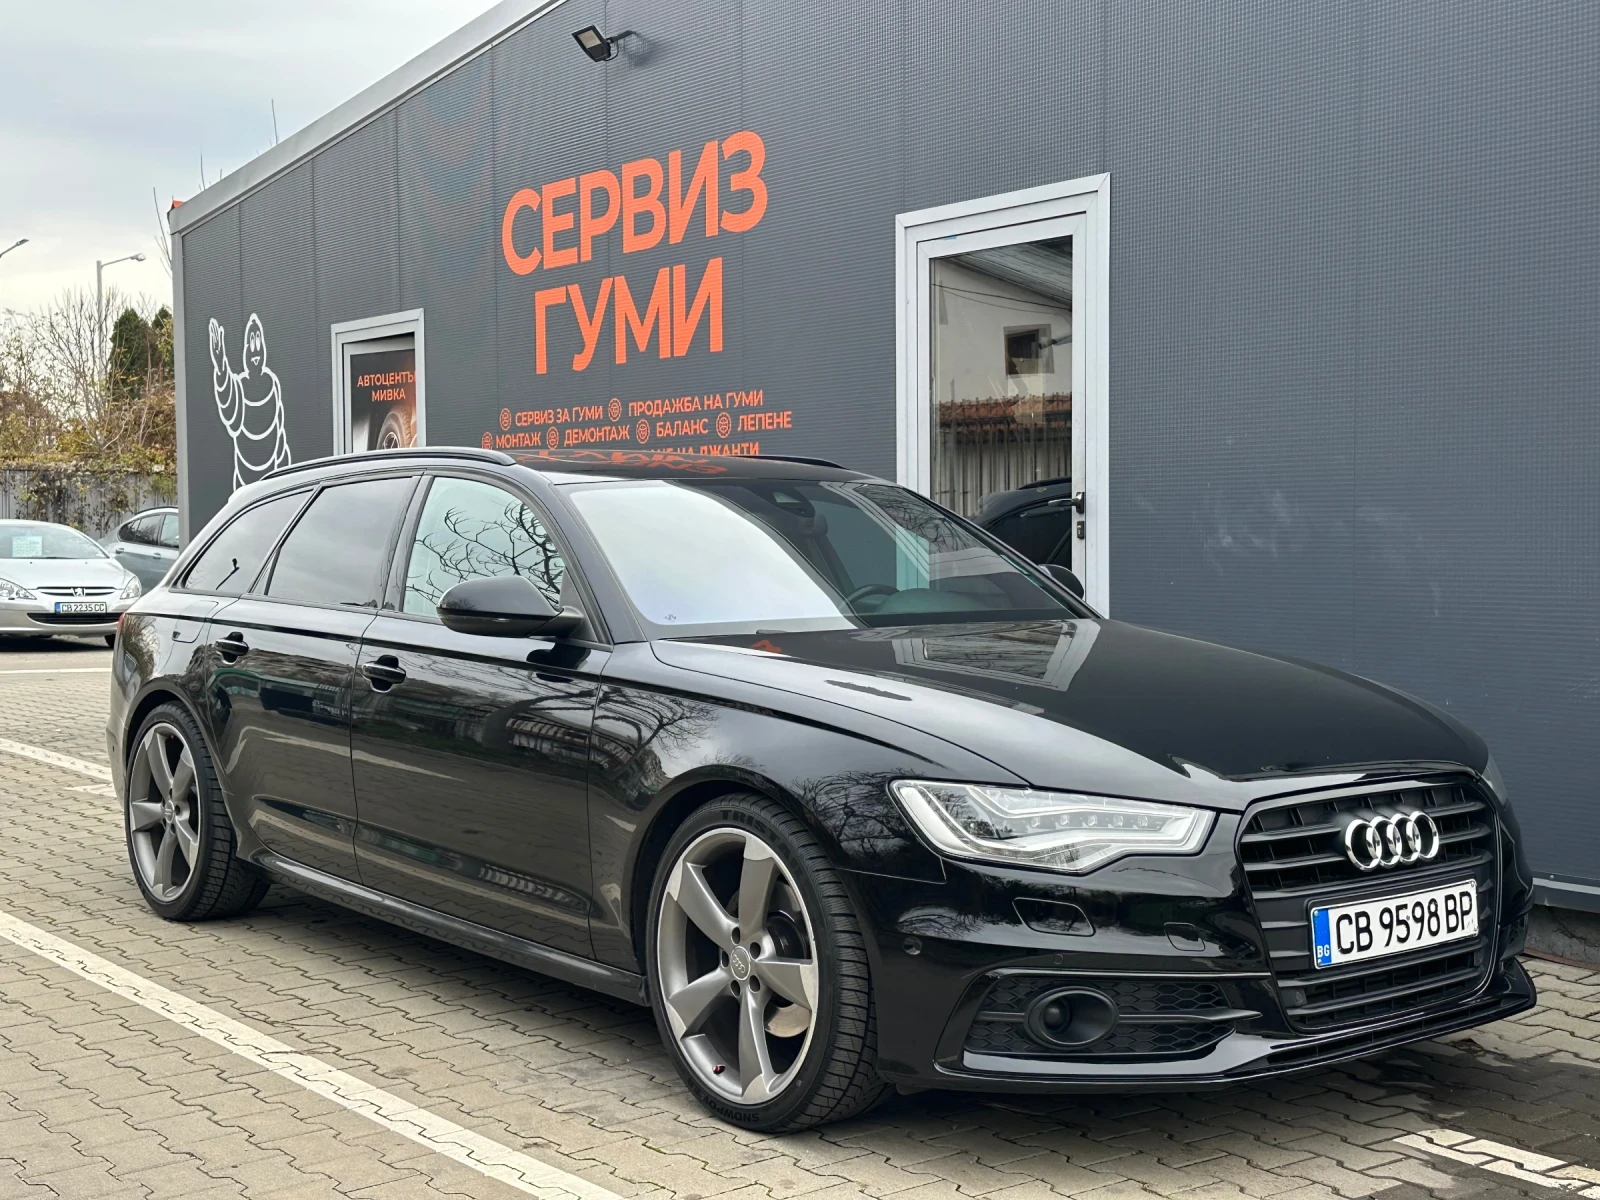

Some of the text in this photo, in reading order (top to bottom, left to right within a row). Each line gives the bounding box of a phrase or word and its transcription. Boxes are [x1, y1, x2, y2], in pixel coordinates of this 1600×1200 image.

[502, 130, 768, 276] СЕРВИЗ
[534, 257, 723, 374] ГУМИ
[372, 388, 405, 402] МИВКА
[628, 389, 764, 418] ПРОДАЖБА НА ГУМИ
[515, 405, 603, 426] СЕРВИЗ ЗА ГУМИ
[737, 411, 792, 432] ЛЕПЕНЕ
[563, 424, 630, 447] ДЕМОНТАЖ
[656, 418, 709, 437] БАЛАНС
[495, 431, 541, 449] МОНТАЖ
[73, 603, 93, 612] 2235
[1336, 890, 1473, 955] CB 9598 BP
[1317, 944, 1330, 958] BG
